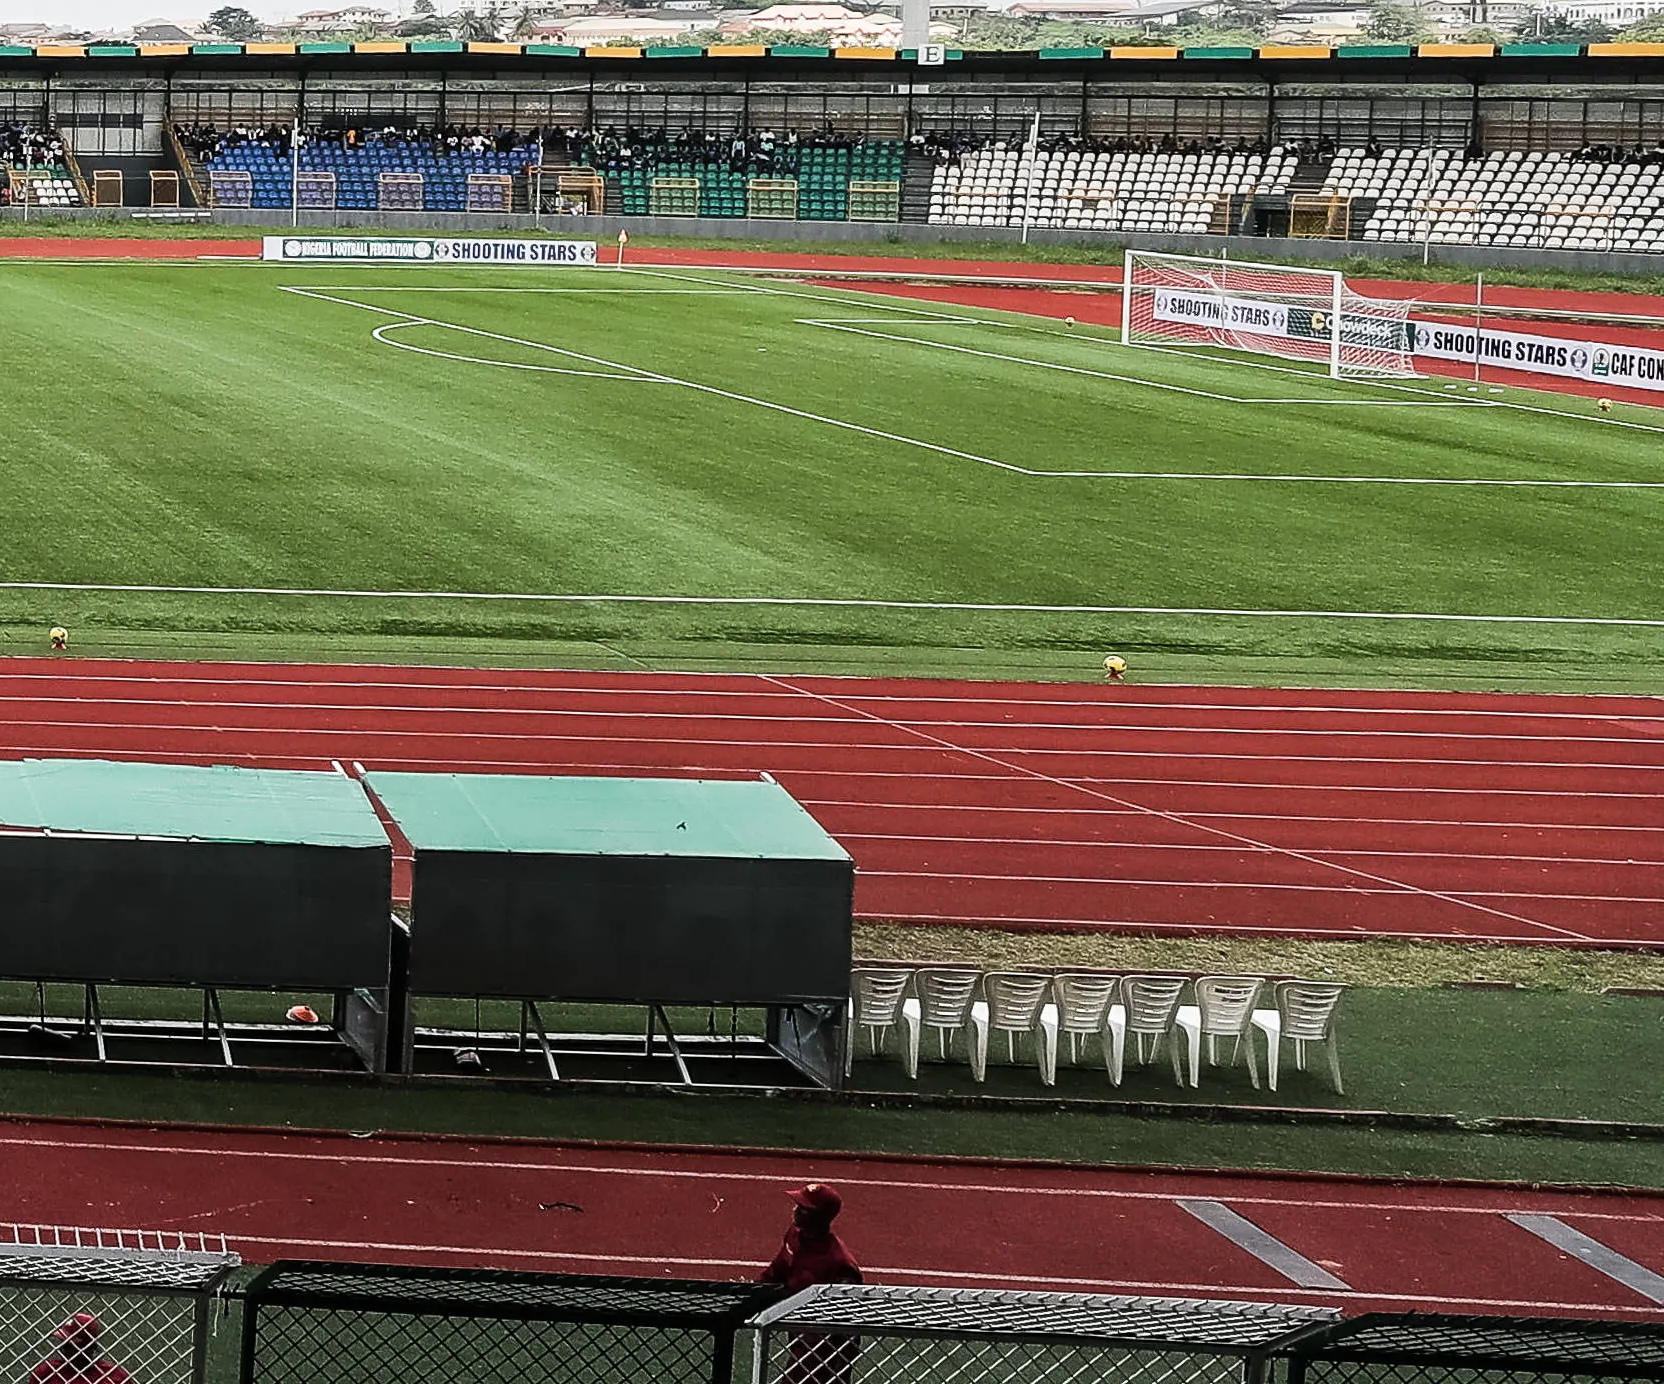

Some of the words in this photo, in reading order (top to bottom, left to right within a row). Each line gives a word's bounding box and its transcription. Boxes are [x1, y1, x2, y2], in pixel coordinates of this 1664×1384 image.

[925, 46, 940, 62] E
[332, 242, 368, 257] FOOTBALL
[452, 243, 525, 260] SHOOTING
[530, 244, 577, 261] STARS
[1170, 297, 1228, 320] SHOOTING
[1231, 305, 1270, 327] STARS
[1433, 331, 1511, 357] SHOOTING
[1515, 342, 1568, 366] STARS
[1611, 353, 1635, 376] CAF
